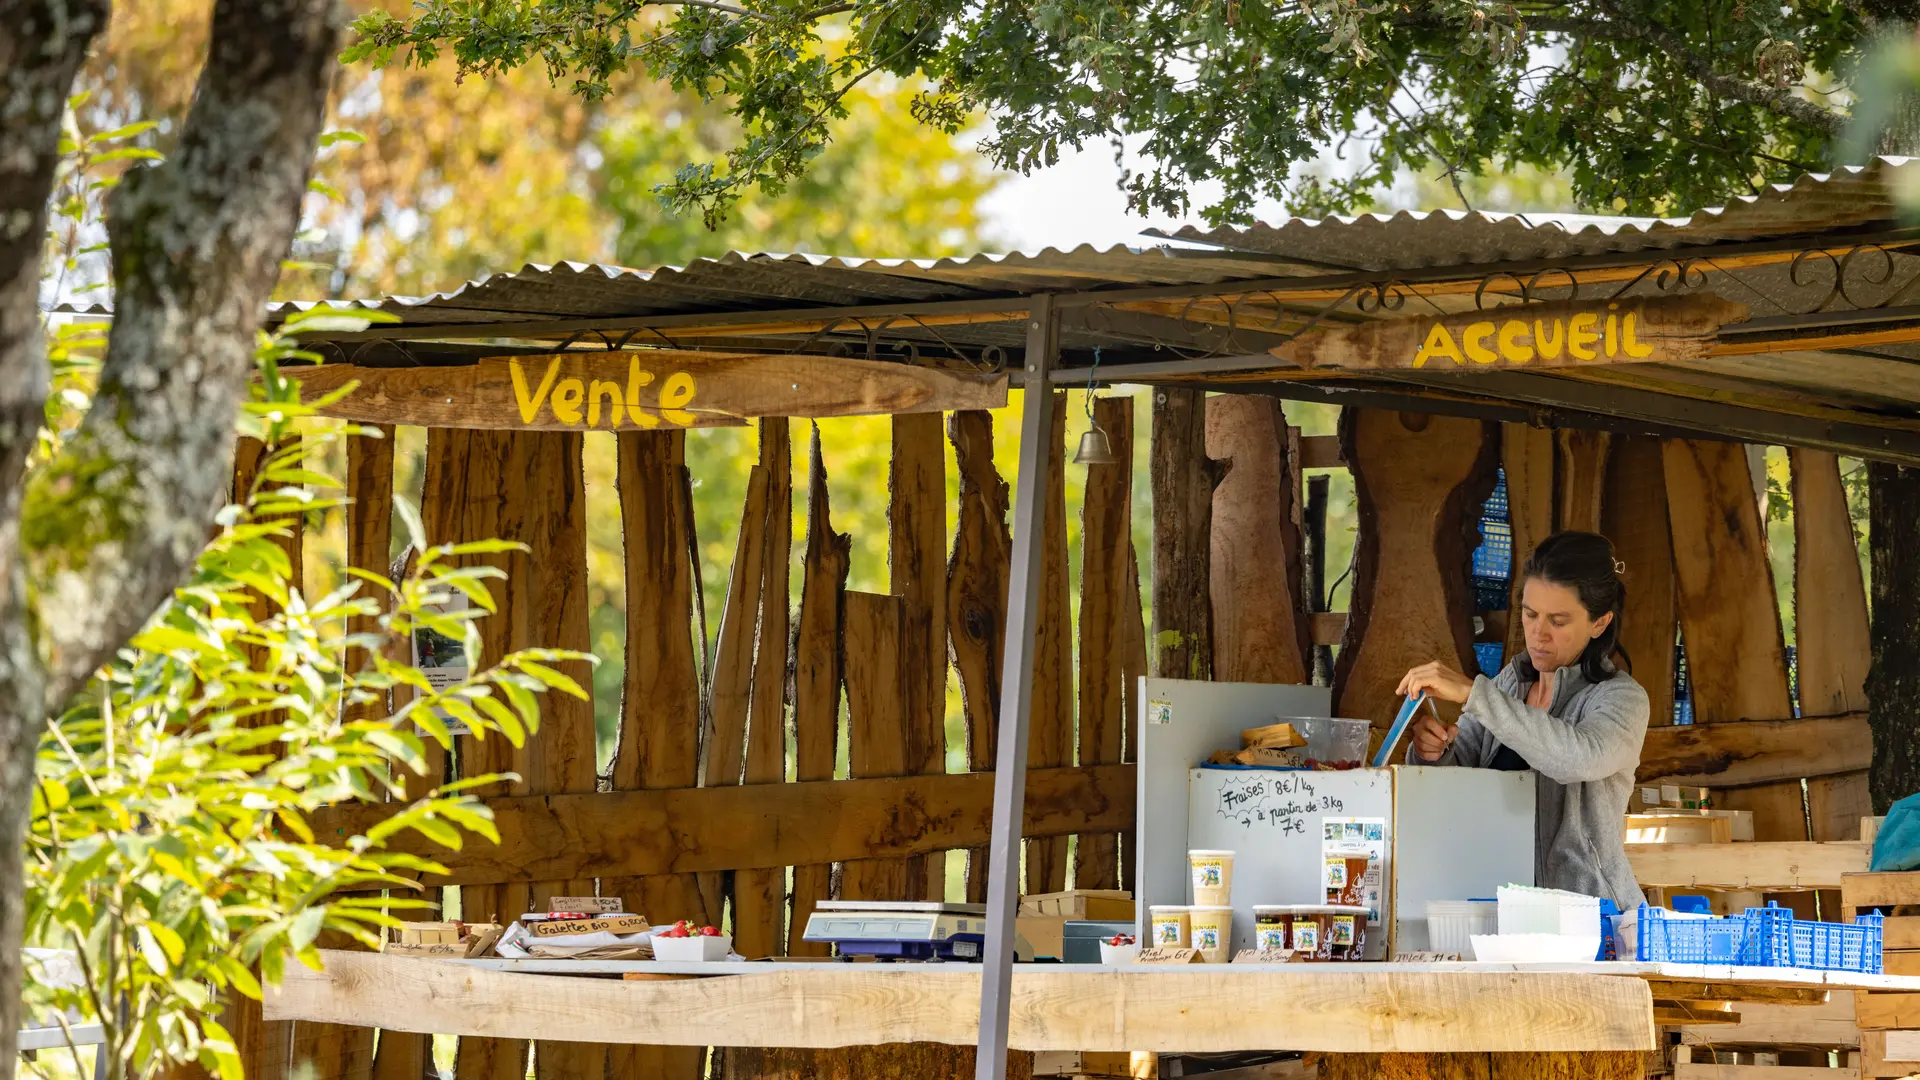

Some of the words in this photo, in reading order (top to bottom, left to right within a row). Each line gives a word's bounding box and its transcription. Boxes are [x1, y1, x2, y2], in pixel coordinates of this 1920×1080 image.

[509, 352, 697, 429] Vente
[1223, 782, 1264, 810] Fraises
[1257, 810, 1265, 820] à
[1270, 801, 1303, 826] partir
[1306, 802, 1317, 813] de
[1280, 818, 1305, 837] 7€
[537, 922, 588, 935] Galettes
[1139, 948, 1163, 957] Miel
